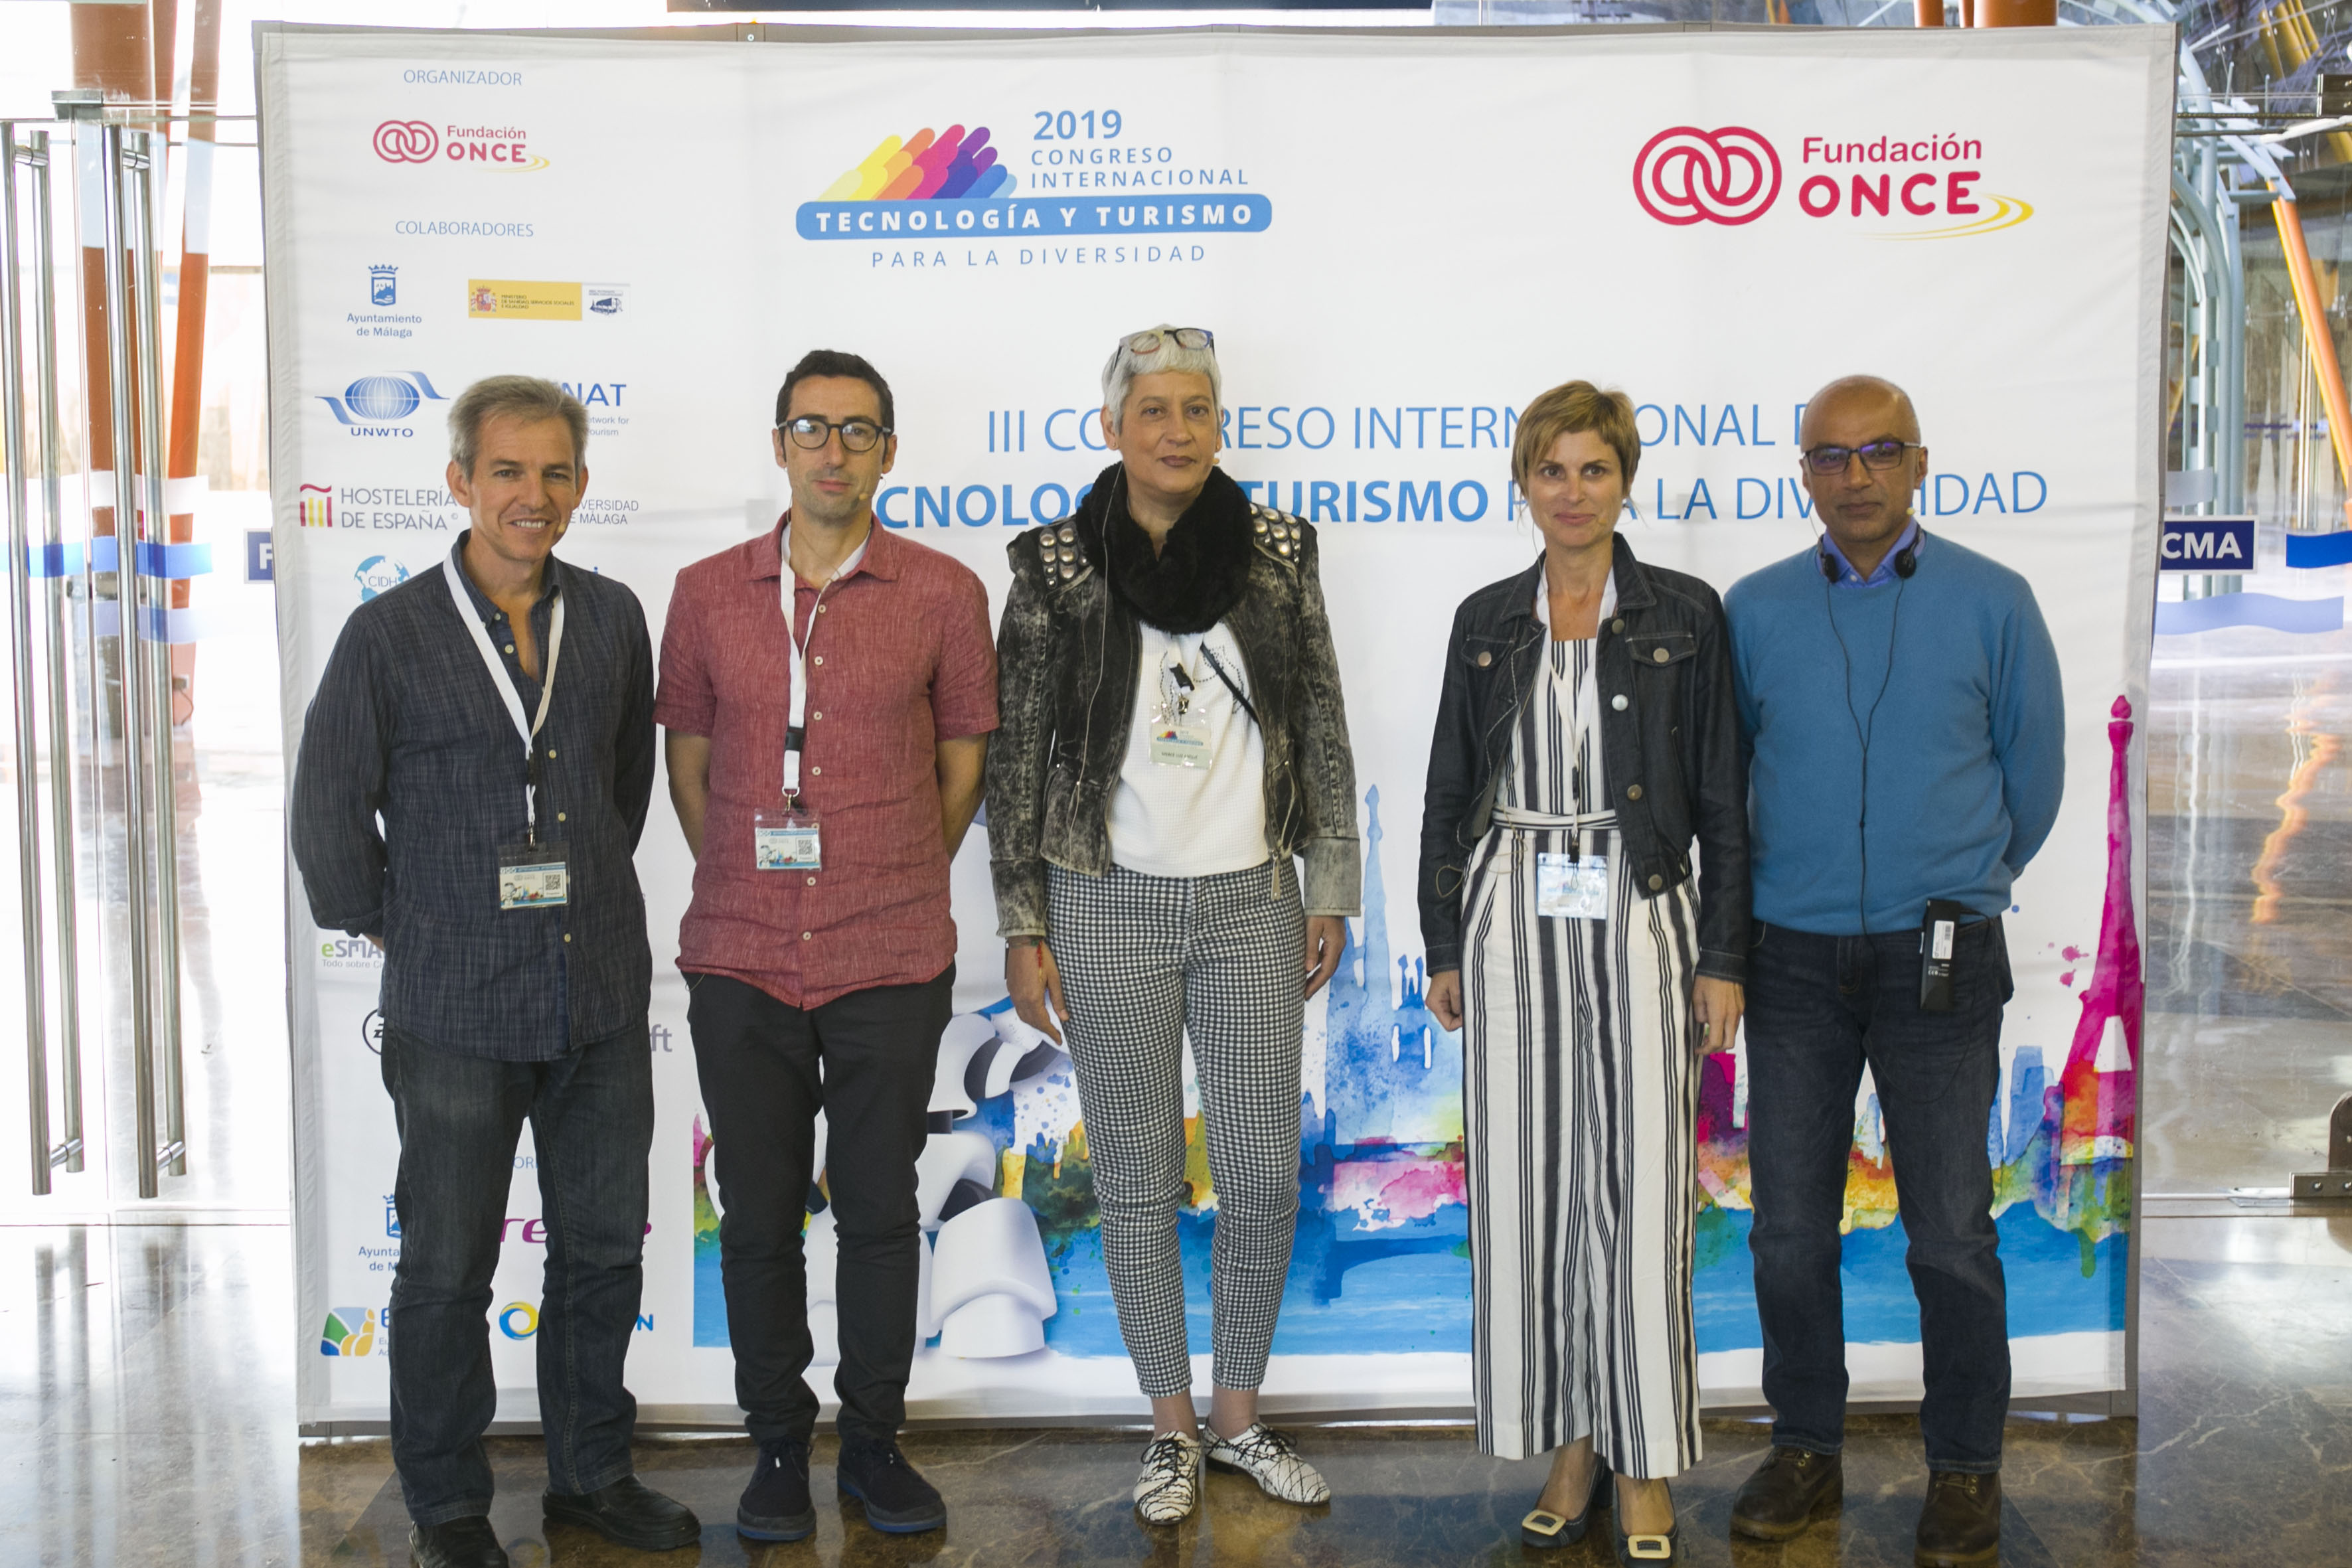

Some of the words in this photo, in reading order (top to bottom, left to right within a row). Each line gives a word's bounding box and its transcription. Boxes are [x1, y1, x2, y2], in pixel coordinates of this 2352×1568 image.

[403, 69, 522, 86] ORGANIZADOR
[447, 125, 526, 139] Fundación
[1033, 110, 1122, 141] 2019
[446, 142, 526, 163] ONCE
[1031, 147, 1172, 166] CONGRESO
[1802, 132, 1982, 164] Fundación
[1032, 169, 1249, 189] INTERNACIONAL
[1799, 171, 1980, 218] ONCE
[816, 204, 1041, 232] TECNOLOGÍA
[1061, 207, 1077, 227] Y
[1097, 204, 1252, 226] TURISMO
[395, 220, 534, 237] COLABORADORES
[872, 251, 947, 268] PARA
[968, 250, 999, 266] LA
[1020, 246, 1204, 265] DIVERSIDAD
[347, 313, 422, 325] Ayuntamiento
[356, 327, 370, 337] de
[372, 327, 413, 339] Málaga
[561, 382, 627, 406] NAT
[589, 416, 615, 425] twork
[617, 416, 629, 425] for
[351, 427, 414, 437] UNWTO
[988, 410, 1025, 453] III
[341, 485, 458, 507] HOSTELERÍA
[876, 483, 1095, 529] CNOLO
[1657, 478, 1718, 520] LA
[1736, 471, 2047, 520] DIVIDAD
[578, 499, 639, 512] VERSIDAD
[341, 511, 366, 528] DE
[373, 510, 448, 530] ESPAÑA
[580, 511, 628, 525] MÁLAGA
[368, 576, 398, 588] CIDH
[323, 959, 343, 967] Todo
[358, 1246, 400, 1258] Ayunta
[369, 1261, 384, 1271] de
